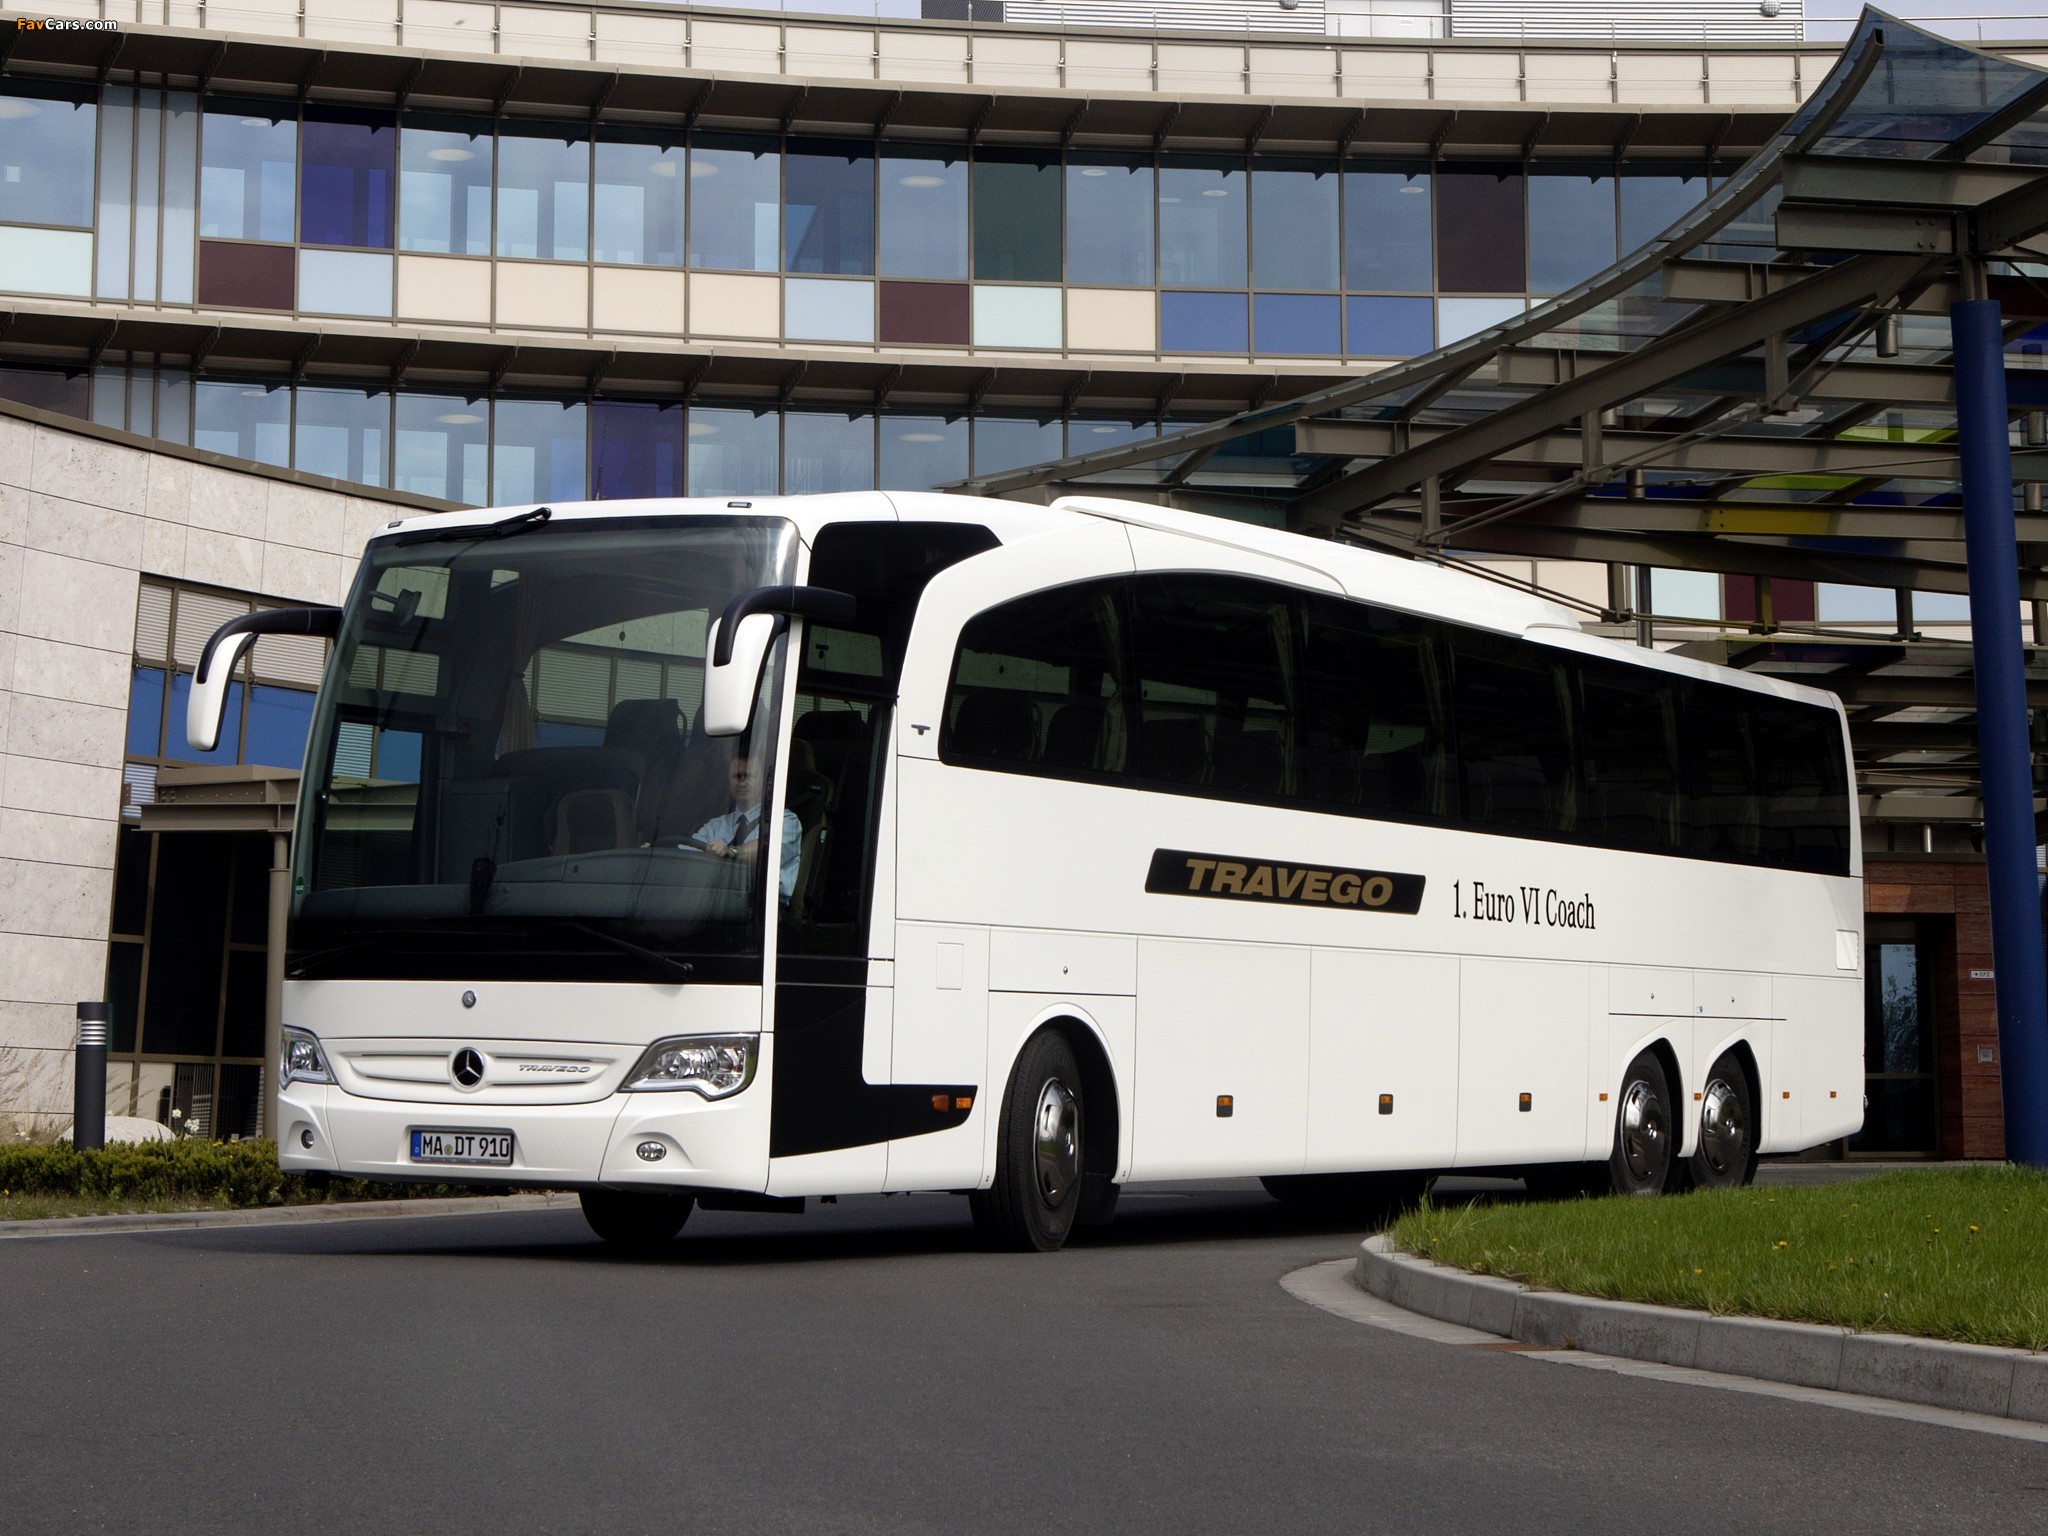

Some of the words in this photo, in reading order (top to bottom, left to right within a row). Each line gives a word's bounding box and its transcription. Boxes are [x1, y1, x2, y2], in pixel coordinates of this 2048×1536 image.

[1185, 858, 1394, 907] TRAVEGO
[1453, 879, 1467, 919] 1.
[1473, 881, 1515, 923] Euro
[1520, 886, 1541, 925] VI
[1546, 888, 1596, 930] Coach
[519, 1064, 591, 1073] TRAVEGO
[422, 1135, 443, 1155] MA
[454, 1136, 475, 1156] DT
[479, 1137, 510, 1158] 910
